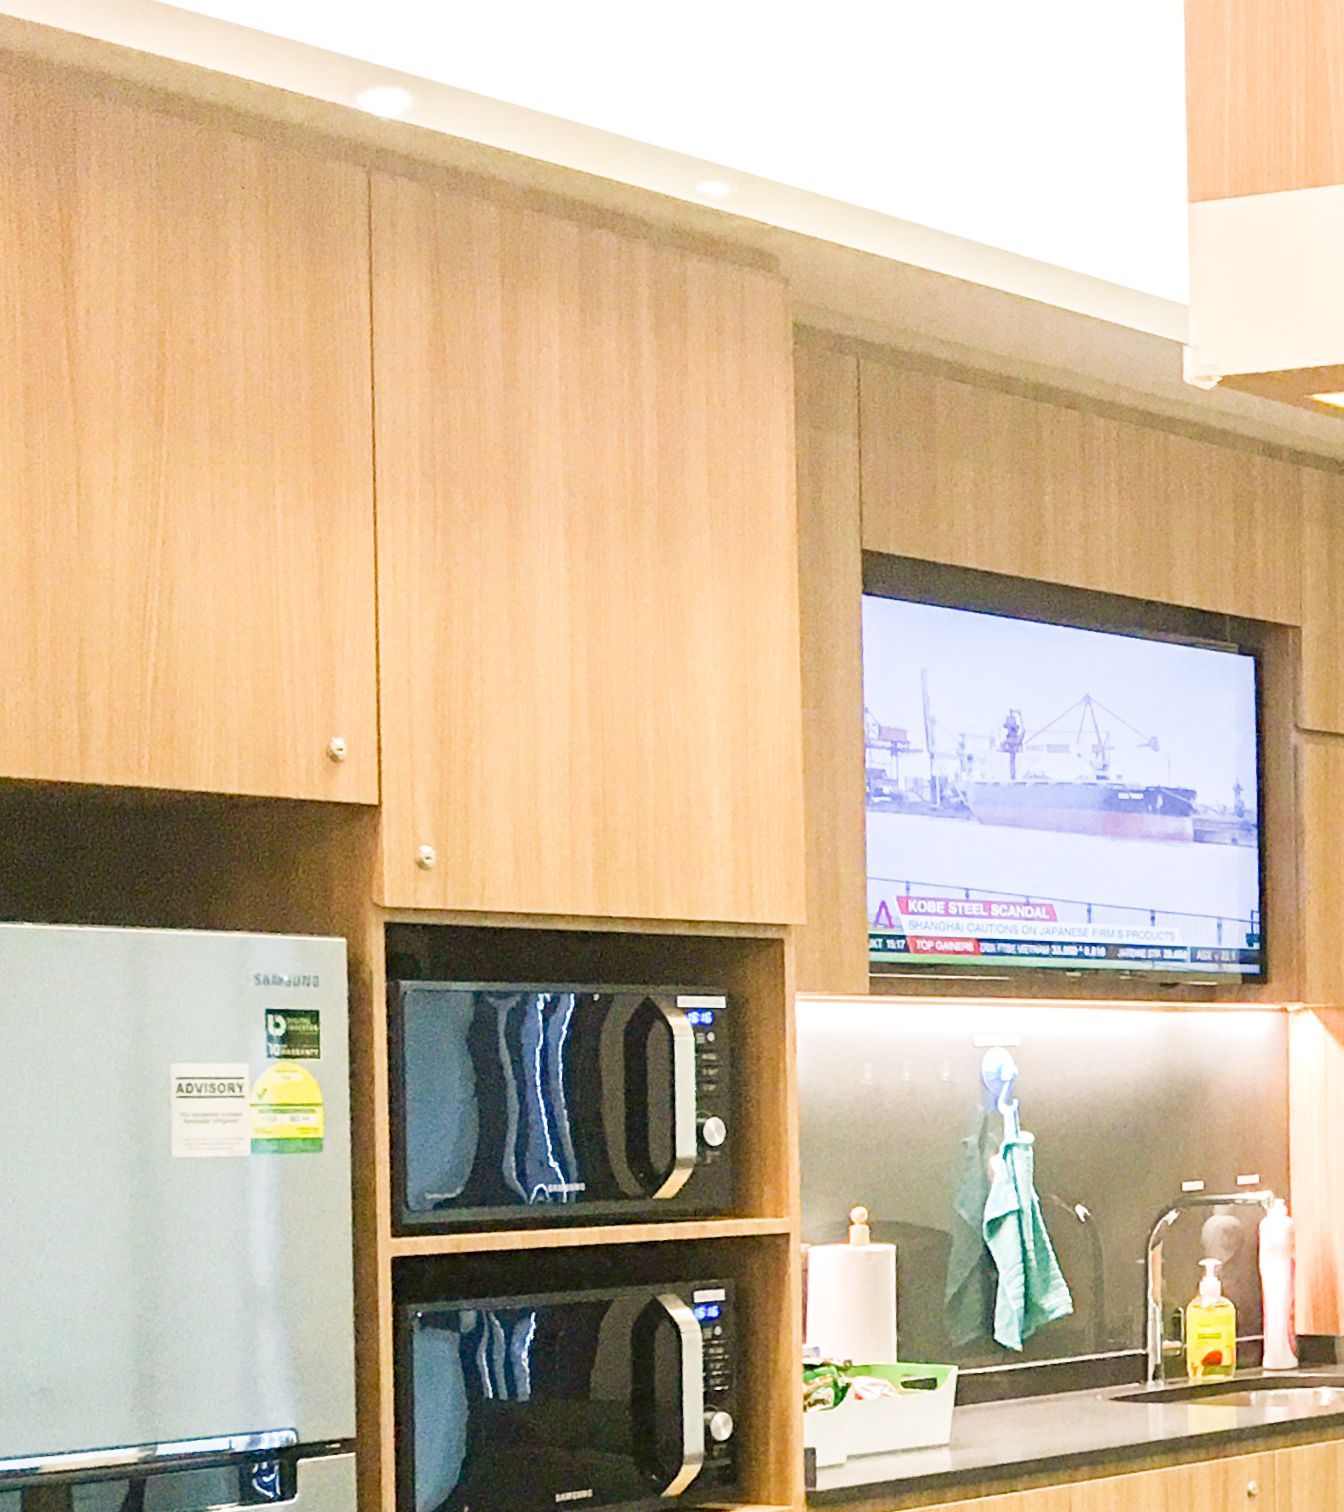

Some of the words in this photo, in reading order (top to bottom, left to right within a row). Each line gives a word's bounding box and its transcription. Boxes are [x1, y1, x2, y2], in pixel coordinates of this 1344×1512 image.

[908, 899, 945, 914] KOBE
[948, 901, 987, 917] STEEL
[991, 903, 1051, 920] SCANDAL
[908, 919, 964, 932] SHANGHAI
[967, 921, 1018, 934] CAUTIONS
[1021, 923, 1037, 935] ON
[1039, 924, 1089, 937] JAPANESE
[1126, 928, 1176, 942] PRODUCTS
[916, 938, 934, 951] TOP
[176, 1082, 245, 1094] ADVISORY
